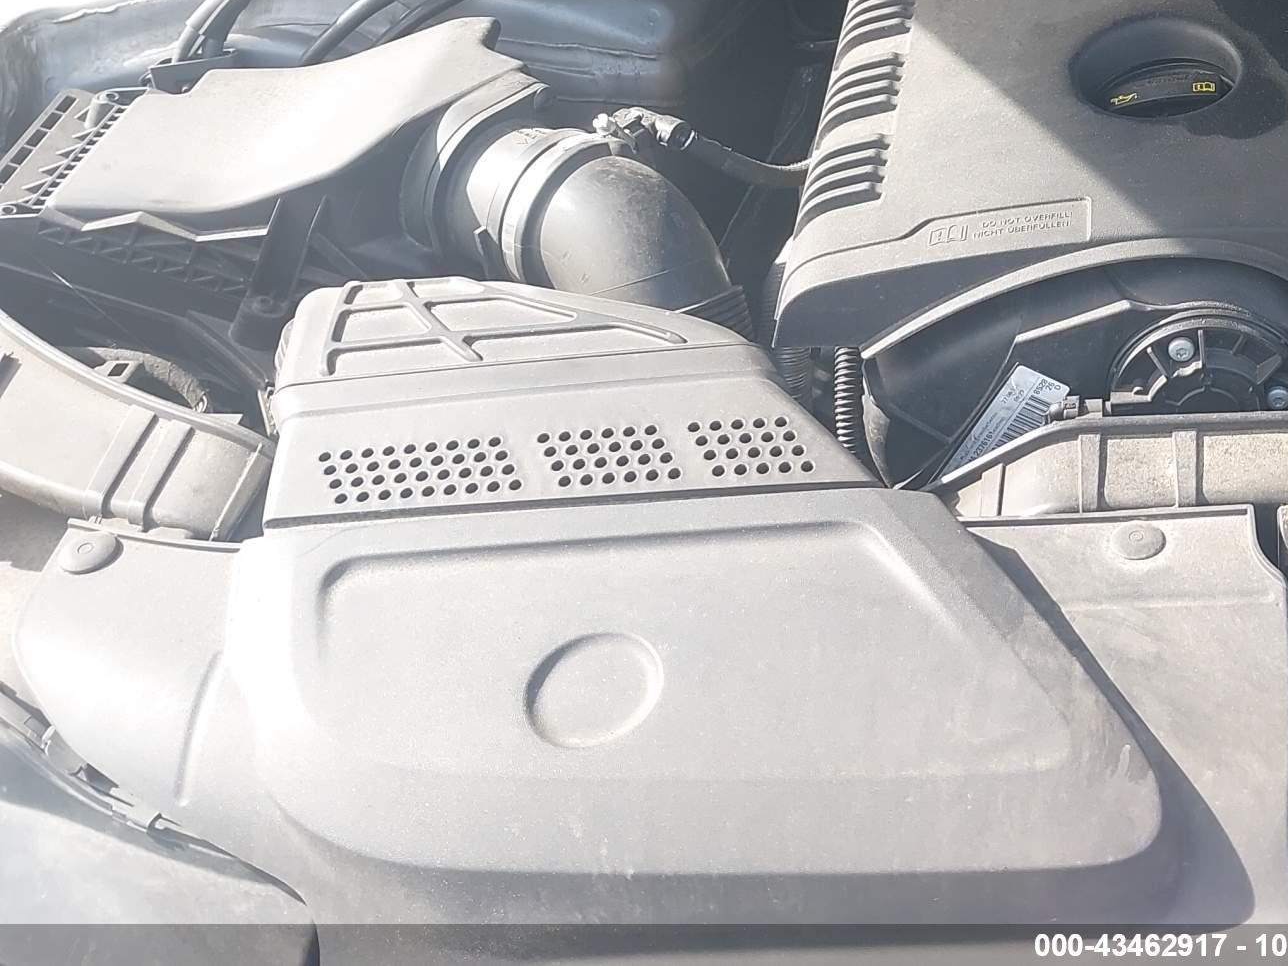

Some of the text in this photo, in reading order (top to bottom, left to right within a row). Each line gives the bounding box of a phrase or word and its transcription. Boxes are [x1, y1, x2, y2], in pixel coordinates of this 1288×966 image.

[982, 220, 997, 228] DO
[1000, 217, 1020, 226] NOT
[973, 228, 1004, 239] NICHT
